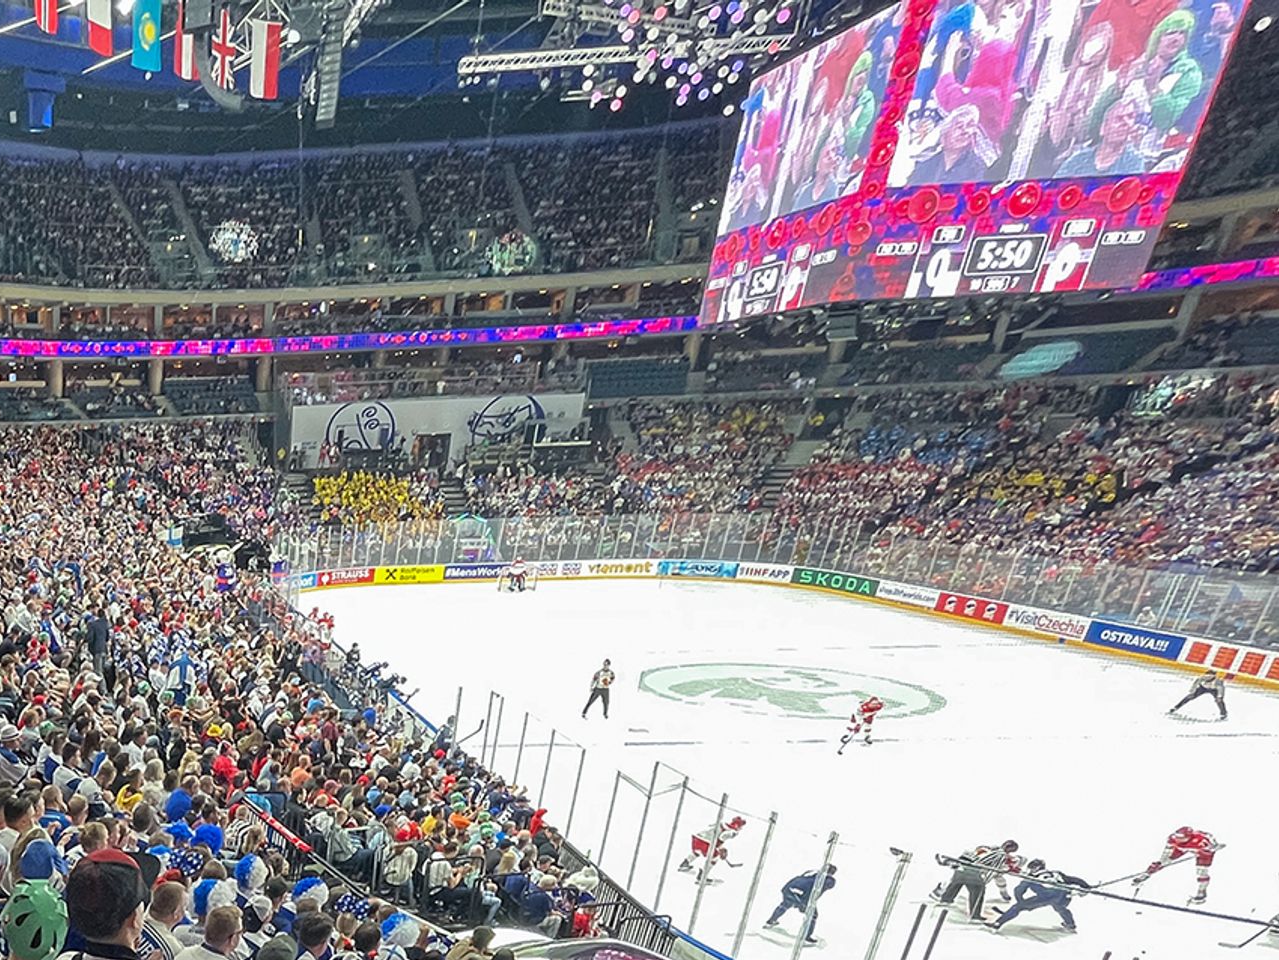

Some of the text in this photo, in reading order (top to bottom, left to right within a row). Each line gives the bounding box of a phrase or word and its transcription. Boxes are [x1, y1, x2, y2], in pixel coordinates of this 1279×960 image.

[976, 240, 1033, 270] 5:50
[331, 570, 370, 580] STRAUSS
[1008, 609, 1086, 636] #VisitCzechia
[1100, 629, 1170, 652] OSTRAVA!!!
